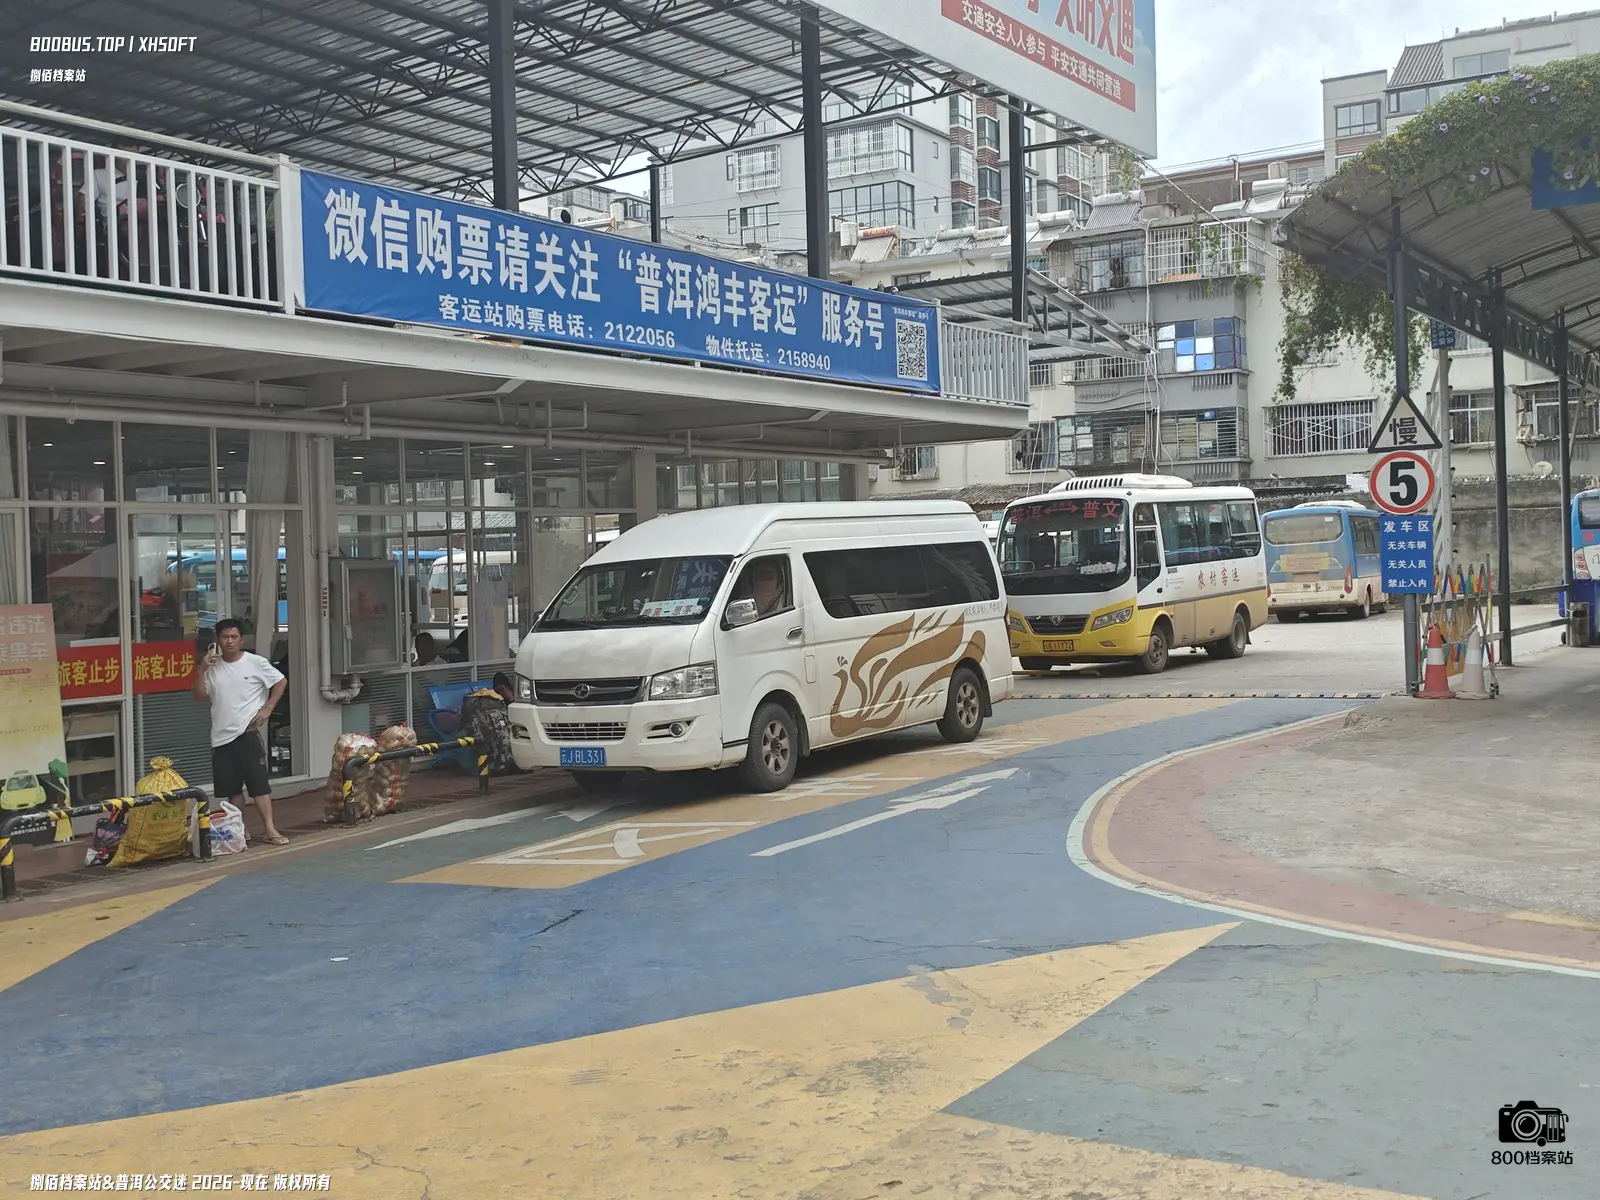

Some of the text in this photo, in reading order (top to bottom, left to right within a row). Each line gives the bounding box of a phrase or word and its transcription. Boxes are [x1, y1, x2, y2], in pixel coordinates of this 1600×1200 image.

[962, 0, 1122, 101] 交通安全人人参与 平安交通共同营造
[324, 187, 601, 303] 微信购票请关注
[821, 291, 885, 350] 服务号
[438, 294, 831, 371] 客运站购票电话： 2122056 物件托运： 2158940
[1388, 416, 1418, 446] 慢
[1389, 460, 1418, 506] 5
[1083, 500, 1121, 519] 普文
[1384, 520, 1430, 533] 发车区
[1387, 540, 1427, 551] 无关车辆
[1387, 560, 1427, 570] 无关人员
[1387, 578, 1427, 588] 禁止入内
[58, 656, 121, 688] 旅客止步
[134, 652, 195, 681] 旅客止步
